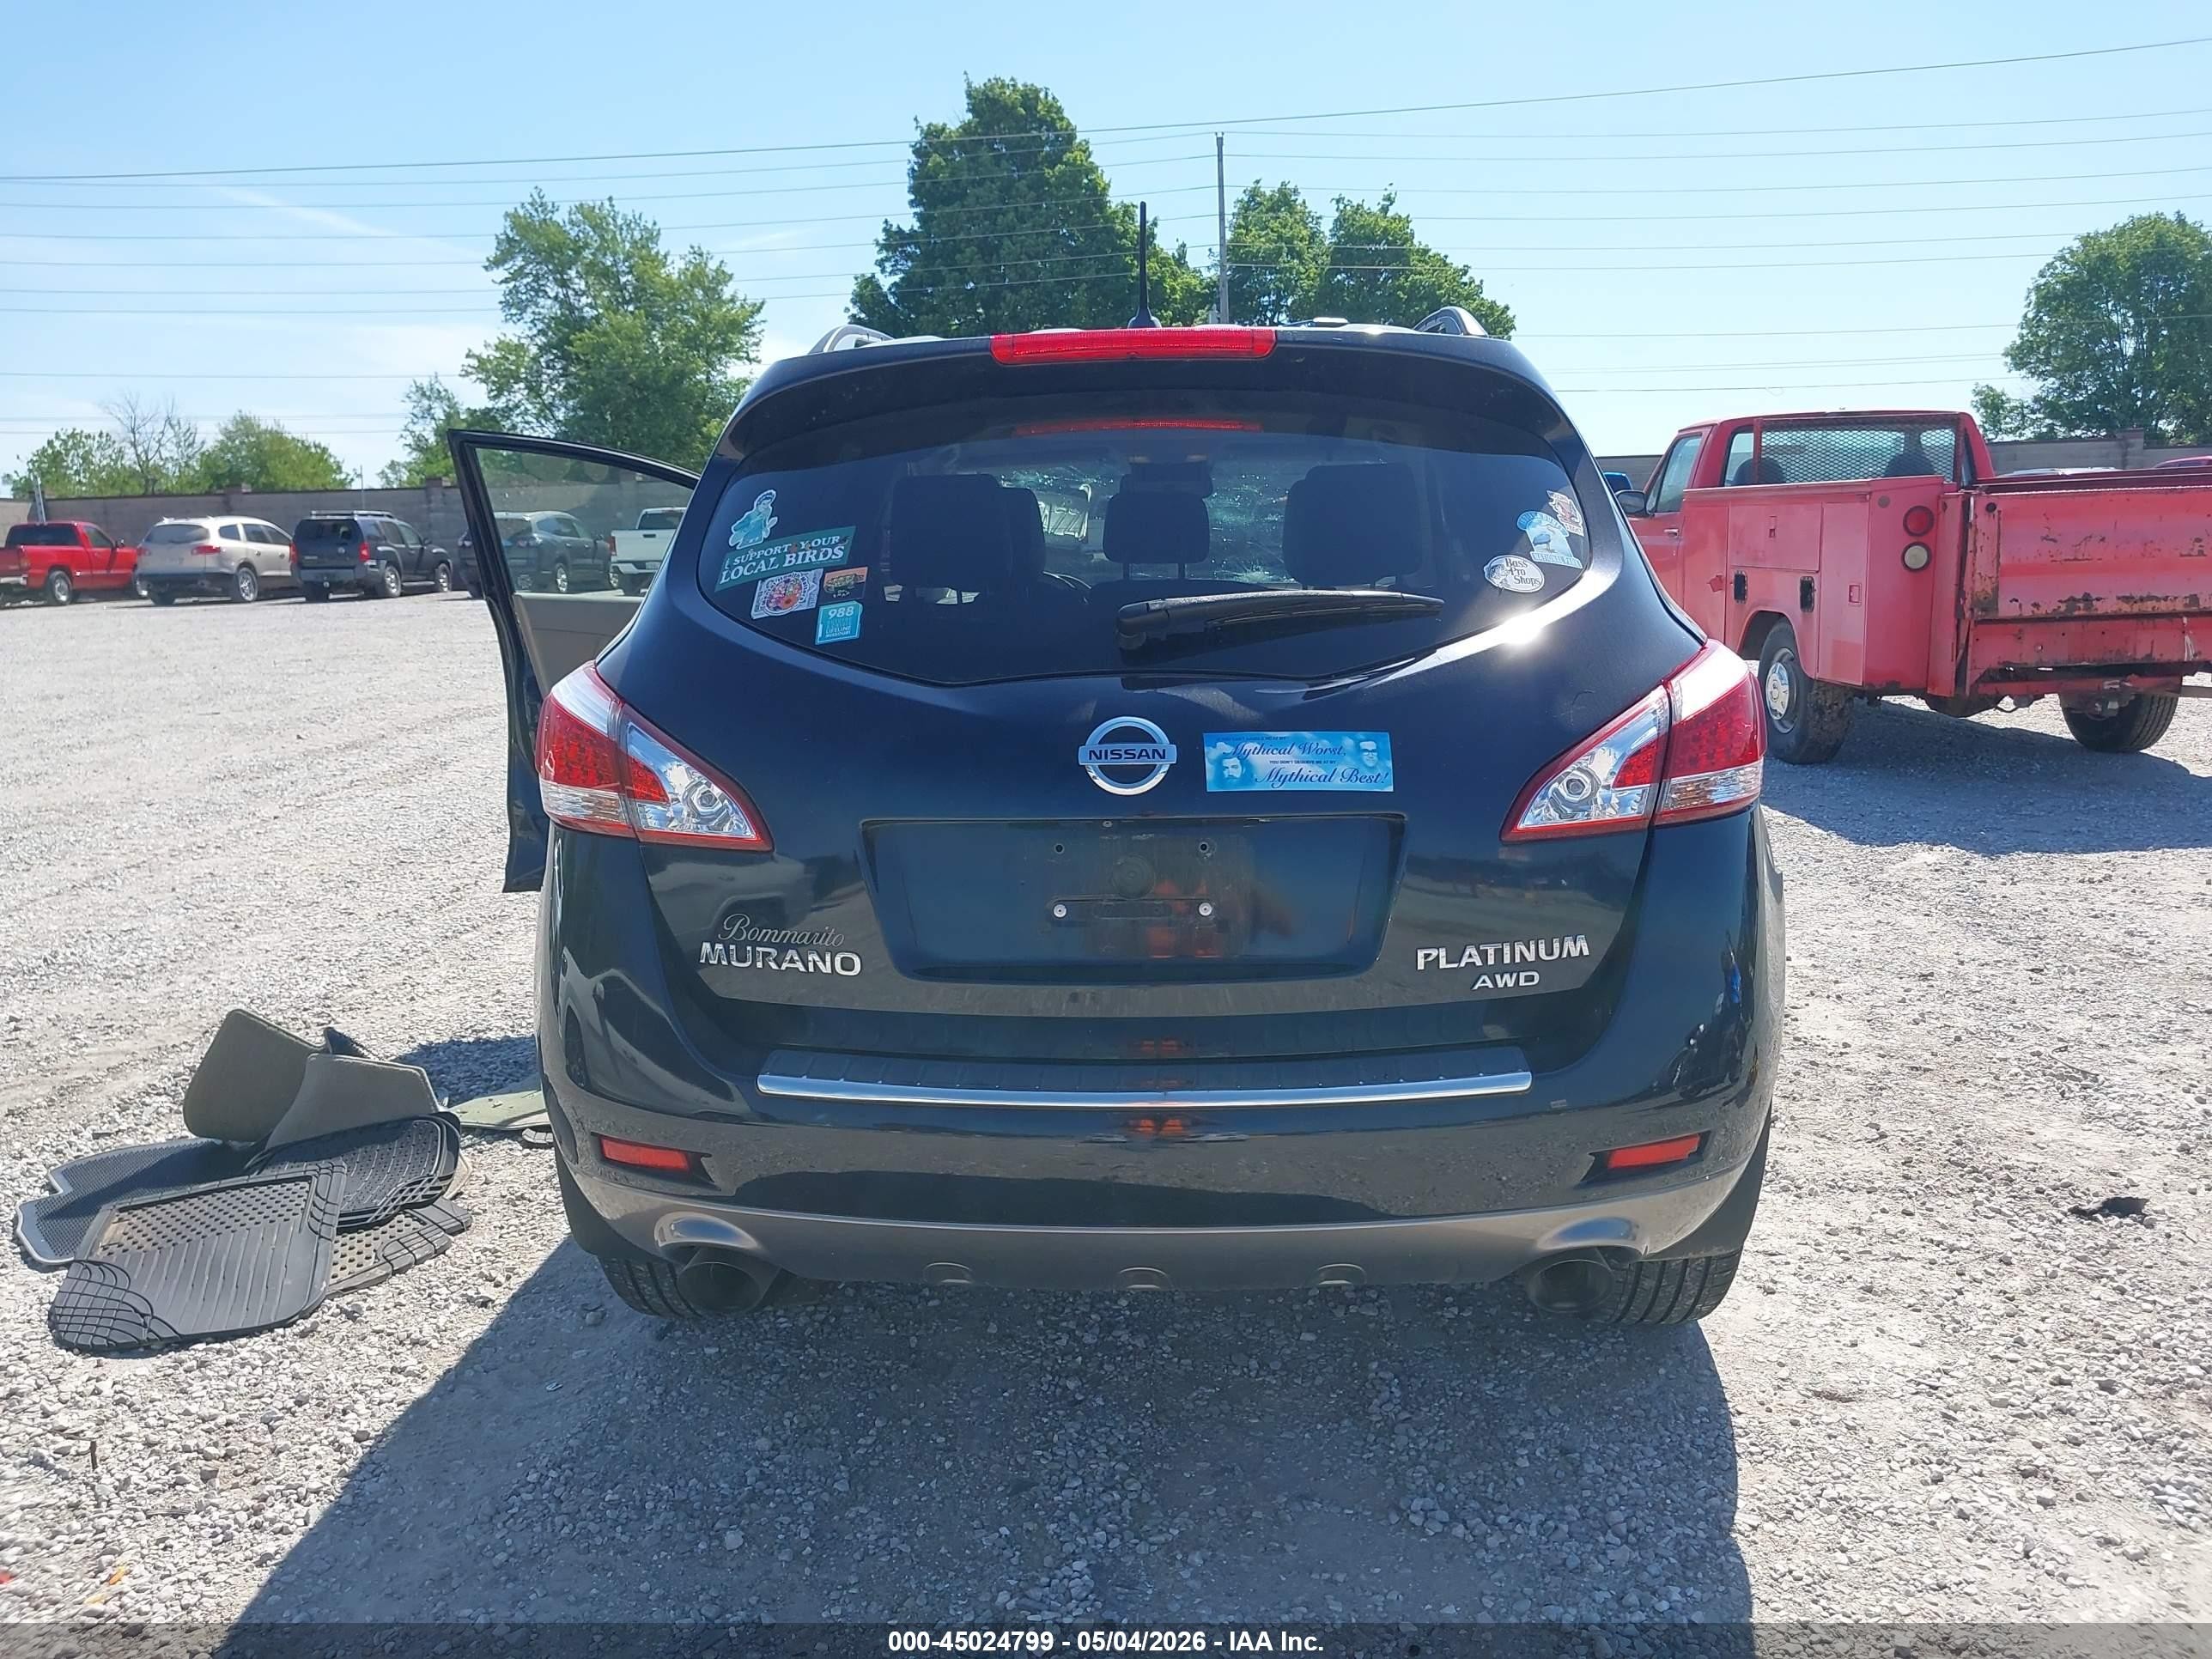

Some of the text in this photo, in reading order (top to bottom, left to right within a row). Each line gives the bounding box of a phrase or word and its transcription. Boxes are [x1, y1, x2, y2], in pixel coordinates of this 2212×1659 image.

[732, 535, 841, 566] SUPPORT YOUR
[719, 545, 845, 585] LOCAL BIRDS
[1504, 557, 1528, 568] Bass
[1510, 568, 1526, 576] Pro
[1514, 575, 1541, 586] Shops
[828, 605, 854, 619] 988
[1089, 748, 1166, 761] NISSAN
[1223, 742, 1346, 758] Mythical Worst,
[1255, 767, 1389, 789] Mythical Best!
[718, 913, 846, 947] Bommarito
[699, 941, 862, 976] MURANO
[1416, 934, 1590, 970] PLATINUM
[1470, 970, 1540, 991] AWD
